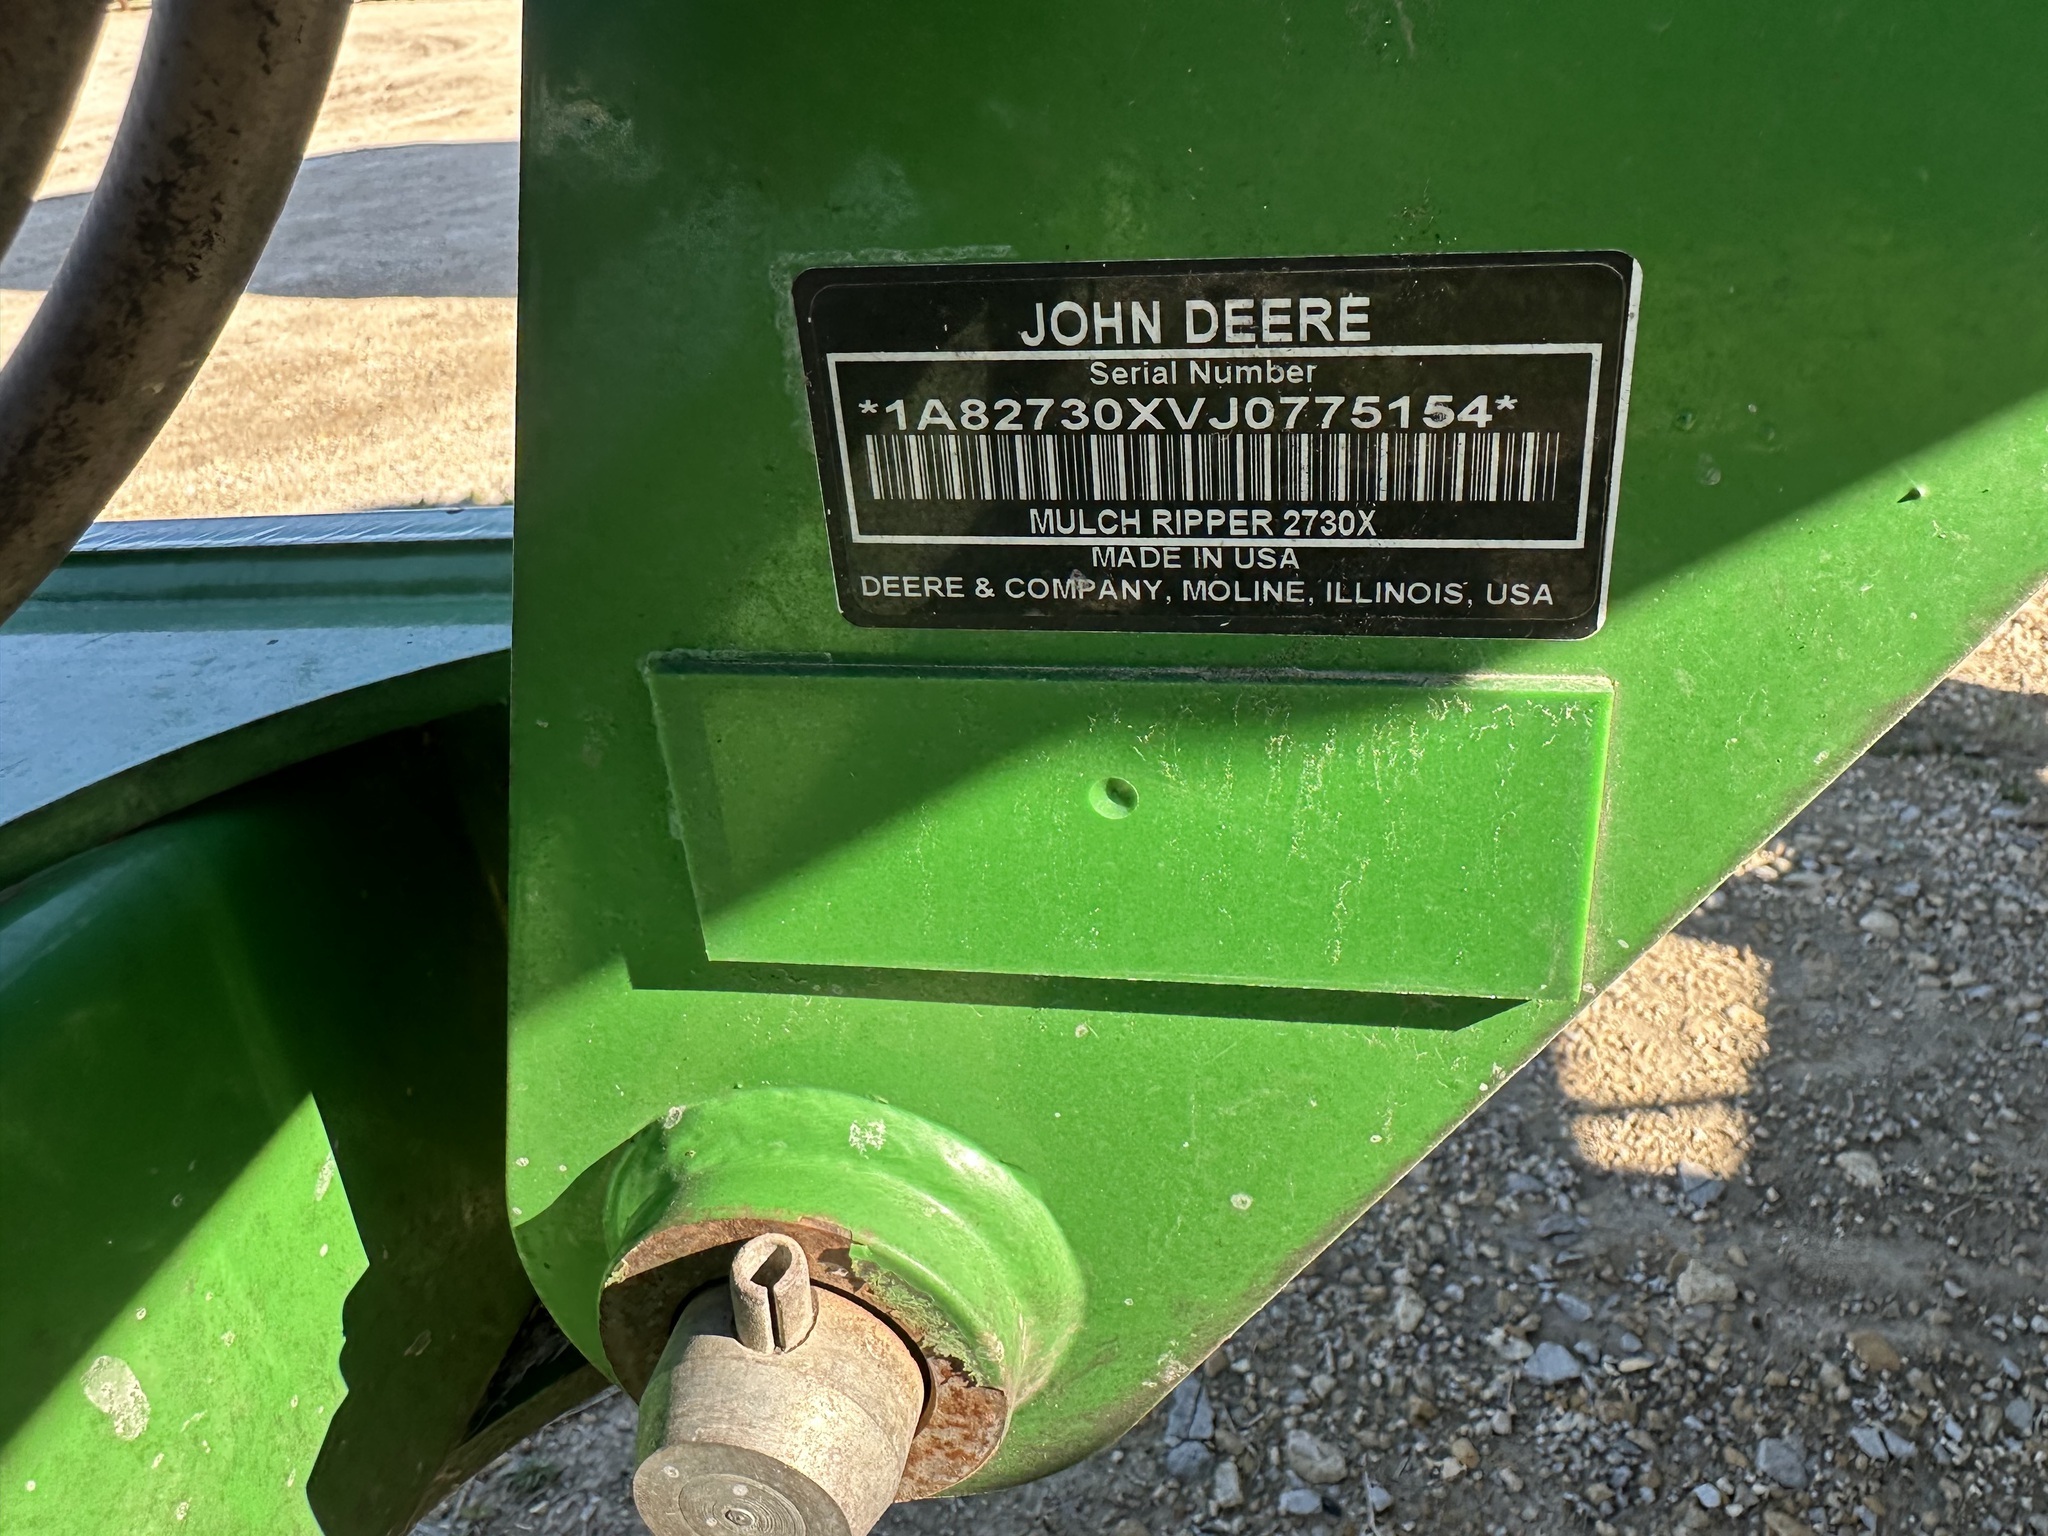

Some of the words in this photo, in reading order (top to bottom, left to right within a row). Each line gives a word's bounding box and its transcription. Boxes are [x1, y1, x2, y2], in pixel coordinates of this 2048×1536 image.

[1020, 301, 1161, 346] JOHN
[1186, 295, 1371, 344] DEERE
[1090, 361, 1177, 385] Serial
[1190, 360, 1318, 384] Number
[1030, 509, 1141, 535] MULCH
[1153, 509, 1273, 536] RIPPER
[1283, 510, 1377, 536] 2730X
[1092, 546, 1181, 568] MADE
[1194, 547, 1222, 569] IN
[1234, 547, 1300, 569] USA
[861, 576, 964, 597] DEERE
[975, 577, 995, 598] &
[1005, 578, 1172, 603] COMPANY,
[1183, 580, 1314, 606] MOLINE,
[1326, 582, 1473, 607] ILLINOIS,
[1486, 583, 1554, 605] USA
